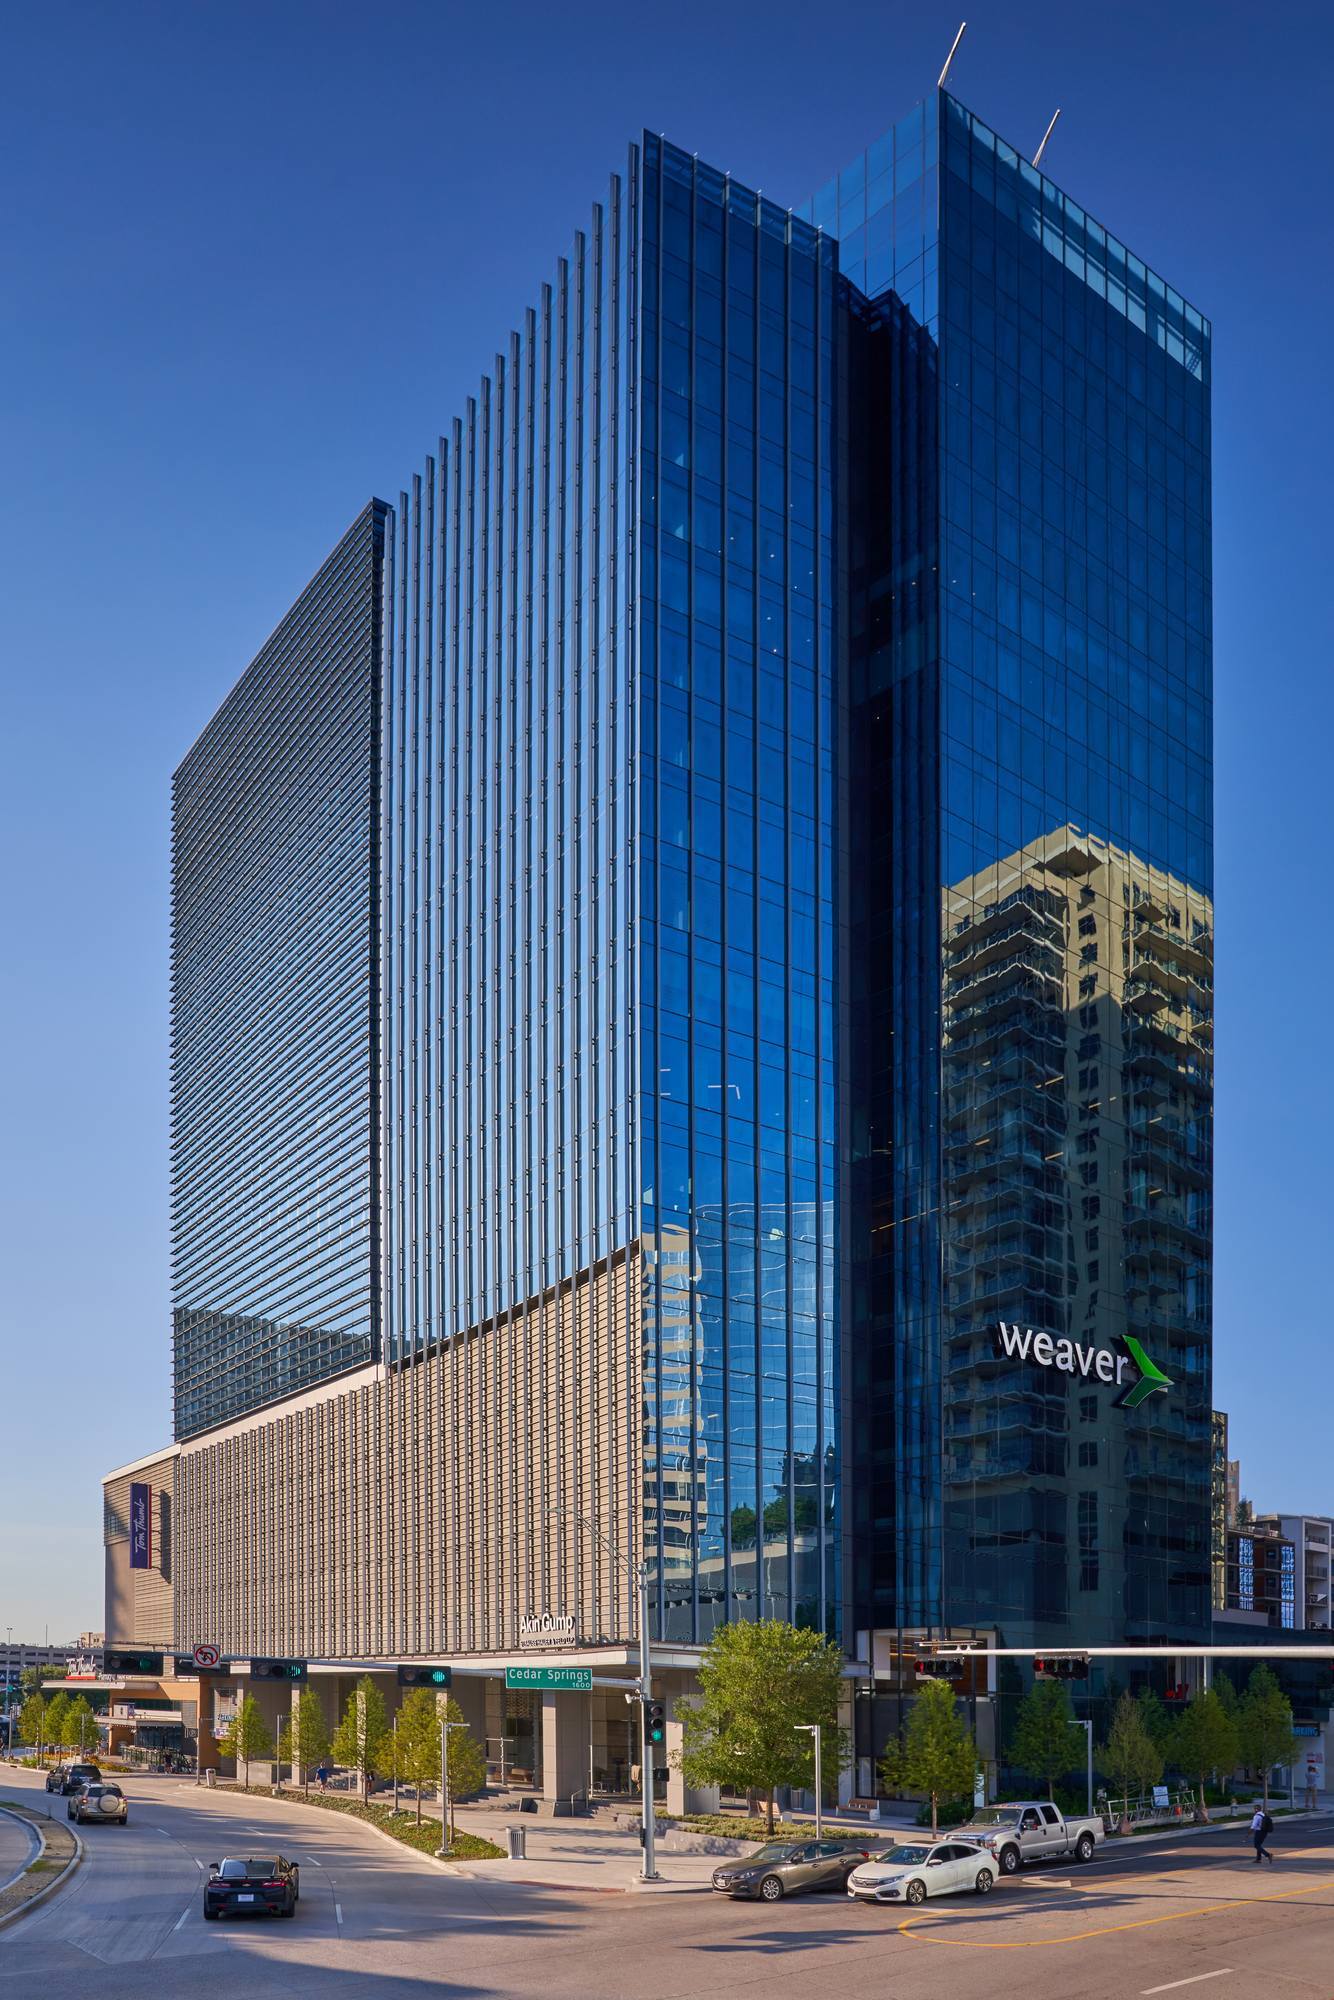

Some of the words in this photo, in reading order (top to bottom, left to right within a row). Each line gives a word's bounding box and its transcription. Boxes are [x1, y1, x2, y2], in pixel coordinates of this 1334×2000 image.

[999, 1321, 1128, 1385] weaver
[134, 1497, 147, 1532] Thumb
[135, 1531, 147, 1553] Tom
[520, 1615, 541, 1634] Akin
[541, 1612, 573, 1635] Gump
[509, 1669, 542, 1680] Cedar
[547, 1669, 589, 1683] Springs
